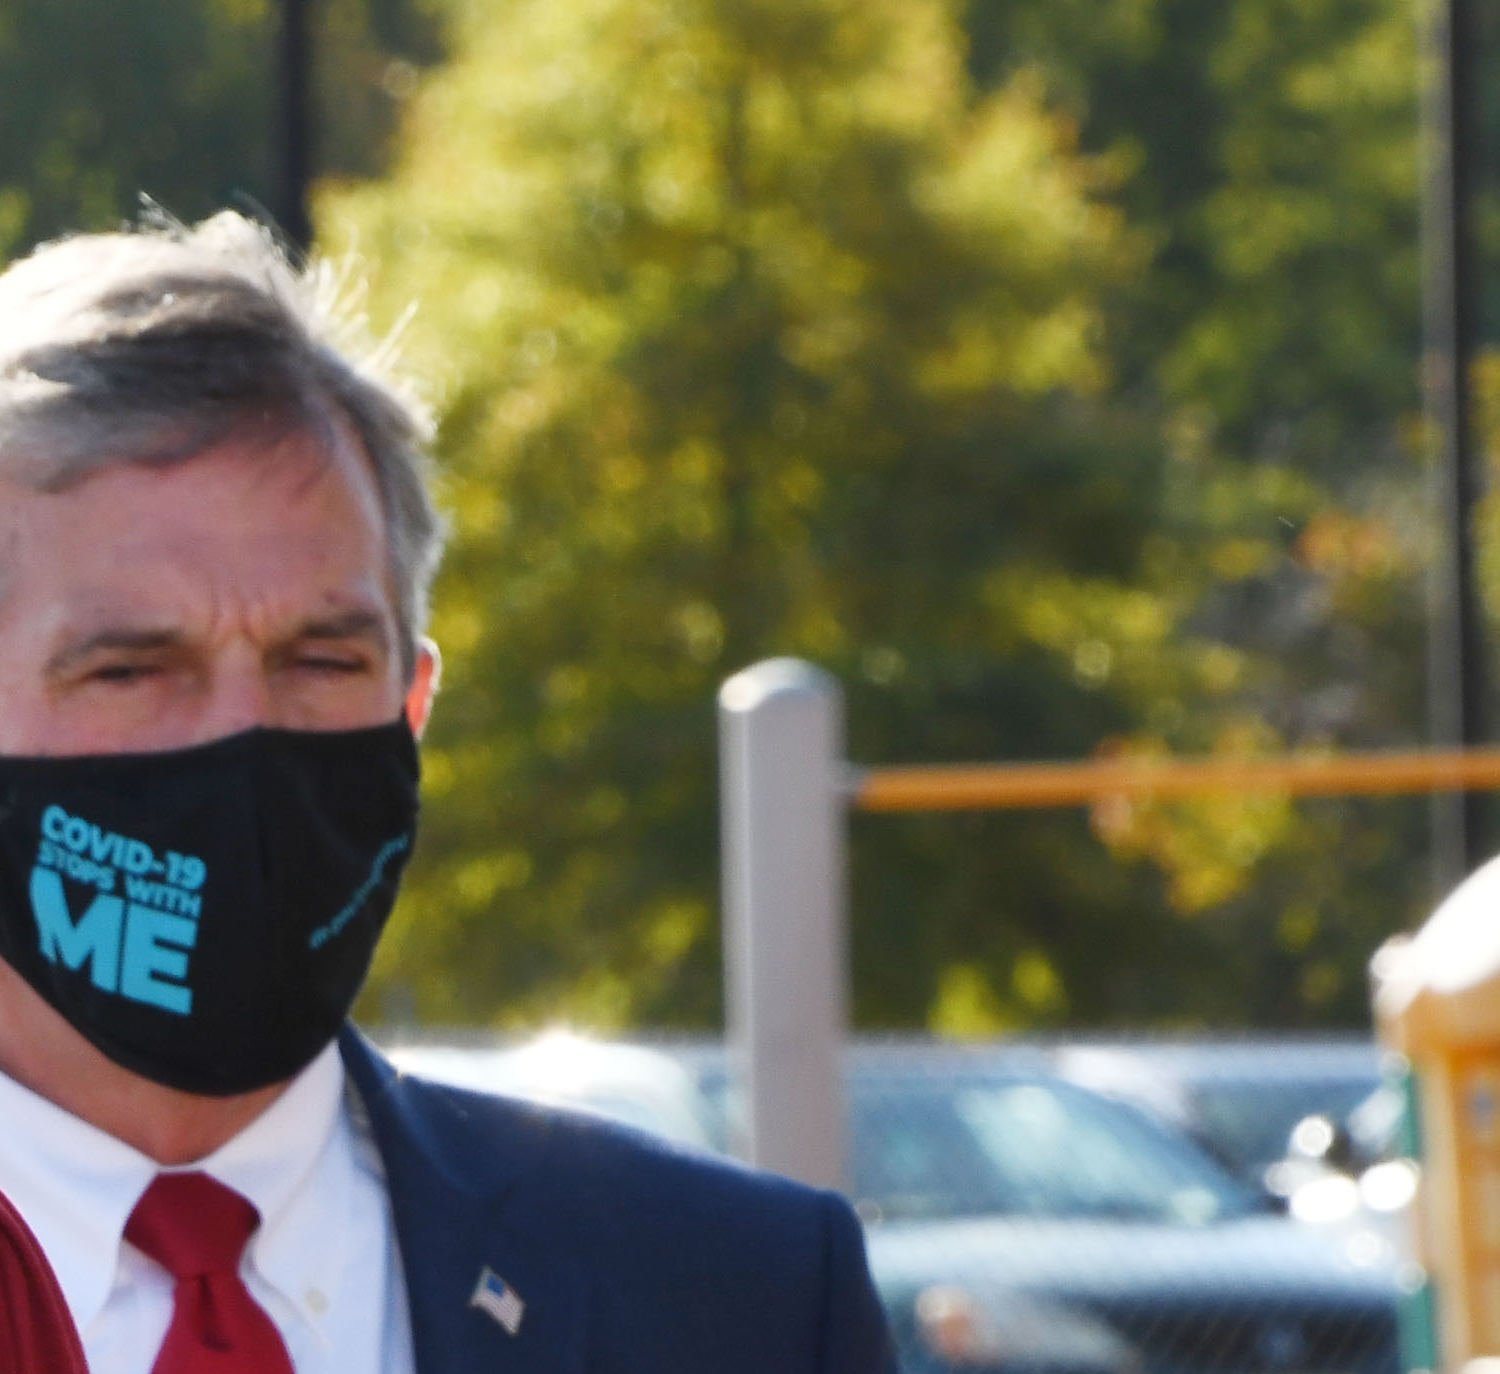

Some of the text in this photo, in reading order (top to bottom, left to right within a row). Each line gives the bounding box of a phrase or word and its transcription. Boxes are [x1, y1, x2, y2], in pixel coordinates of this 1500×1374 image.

[38, 838, 203, 921] STOPS WITH
[41, 804, 207, 890] COVID-19
[29, 866, 198, 1016] ME
